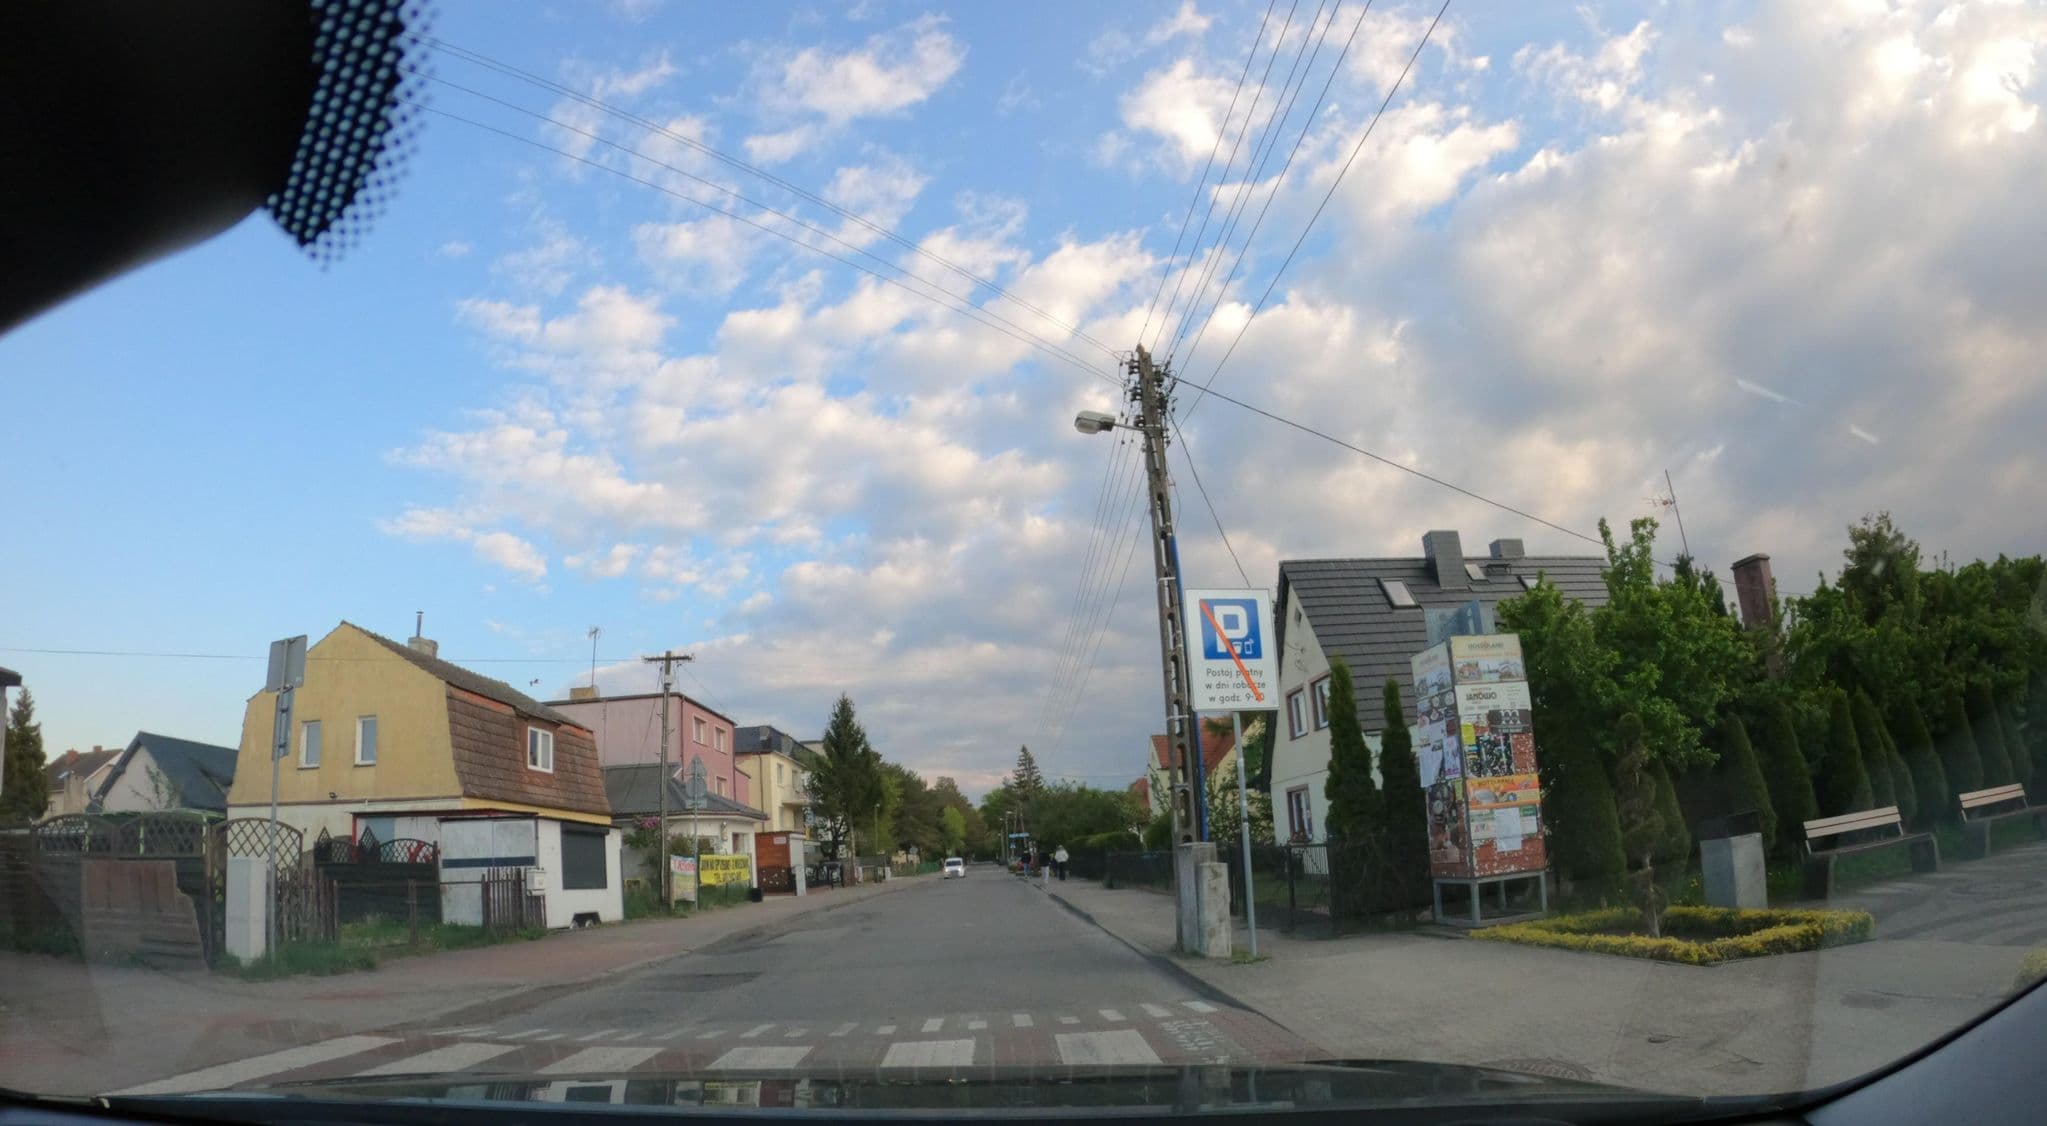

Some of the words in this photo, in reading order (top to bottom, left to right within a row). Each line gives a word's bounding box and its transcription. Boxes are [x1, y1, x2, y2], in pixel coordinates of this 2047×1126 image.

[1214, 606, 1248, 652] P
[1215, 681, 1229, 690] dni
[1218, 694, 1241, 704] godz.
